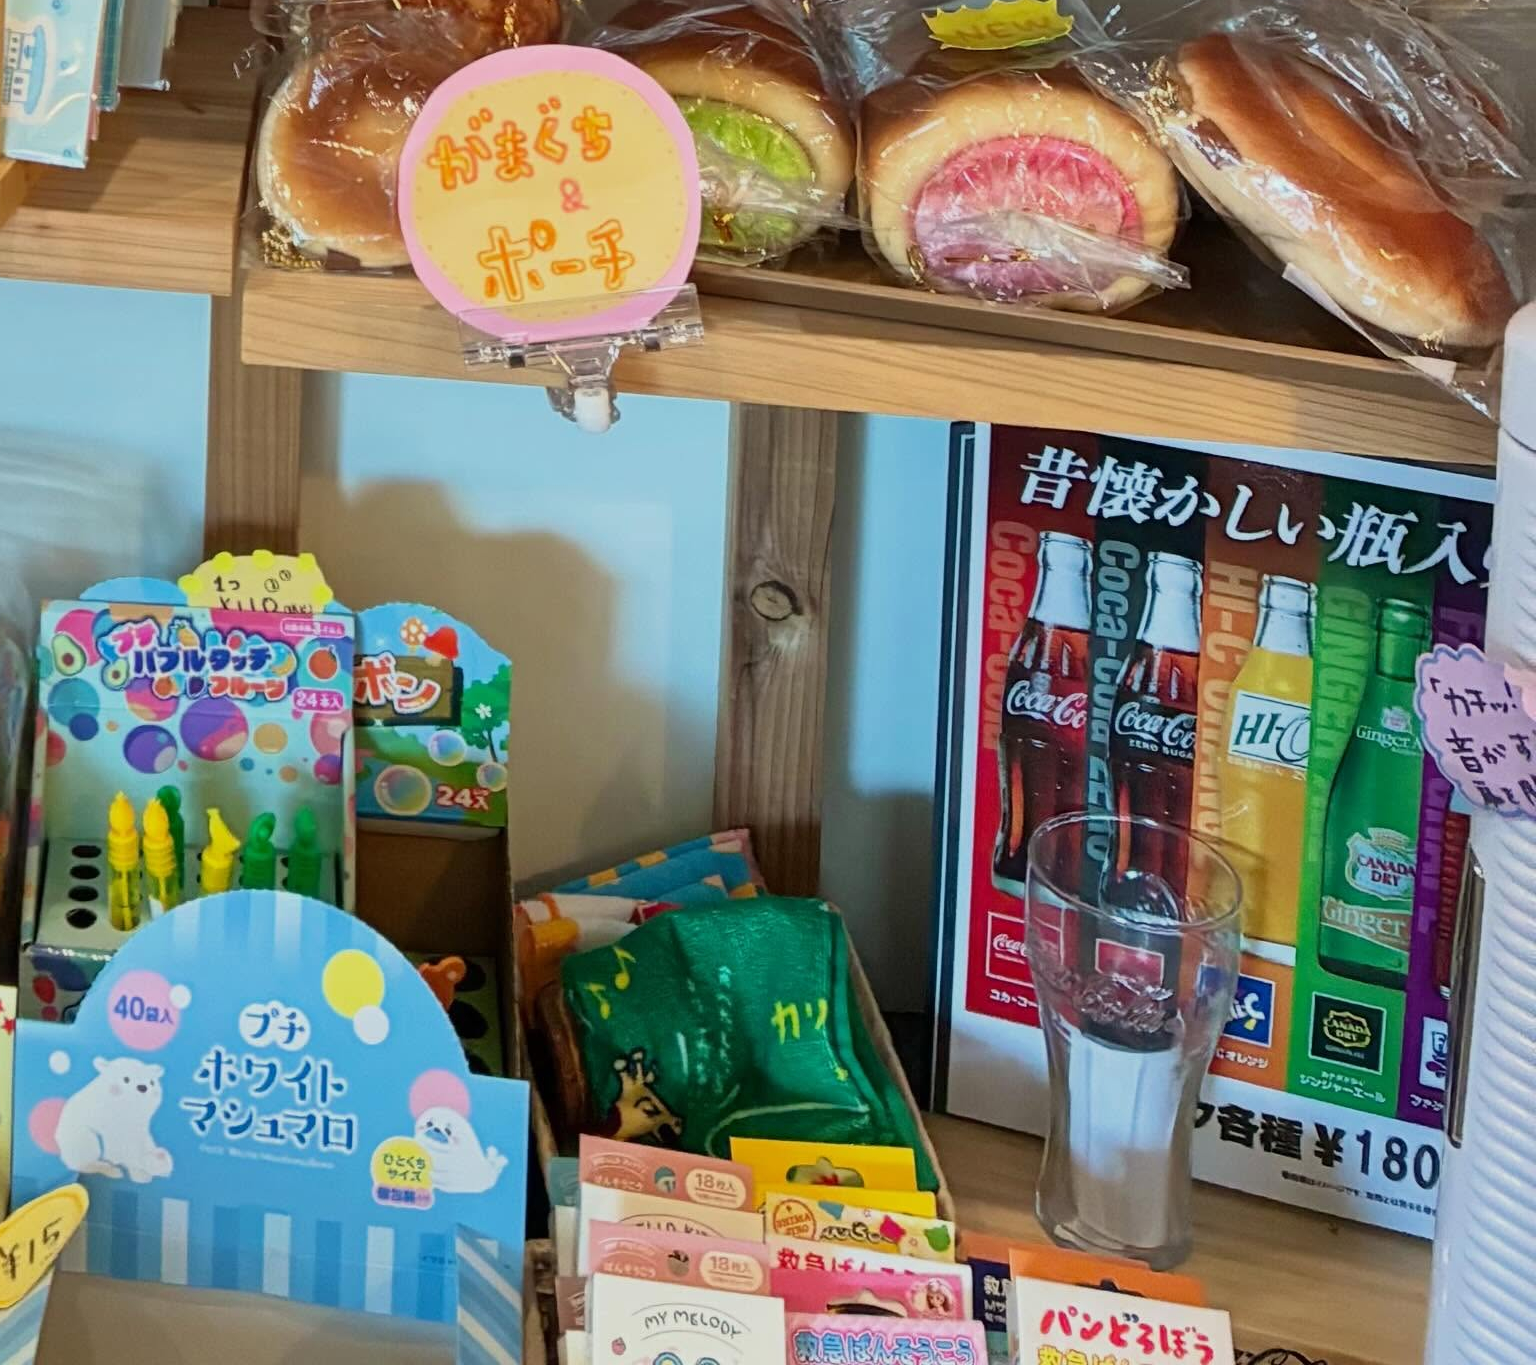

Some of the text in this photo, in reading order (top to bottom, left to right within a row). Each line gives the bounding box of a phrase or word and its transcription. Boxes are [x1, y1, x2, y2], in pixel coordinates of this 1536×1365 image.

[951, 15, 1052, 44] NEW
[427, 96, 613, 191] がまぐち
[559, 178, 590, 213] &
[476, 218, 636, 304] ポーチ
[113, 994, 174, 1025] 40袋入
[245, 1004, 306, 1042] プチ
[199, 1050, 345, 1104] ホワイト
[180, 1098, 356, 1152] マシュマロ
[1314, 1121, 1441, 1191] ¥180
[644, 1309, 743, 1341] MY MELODY
